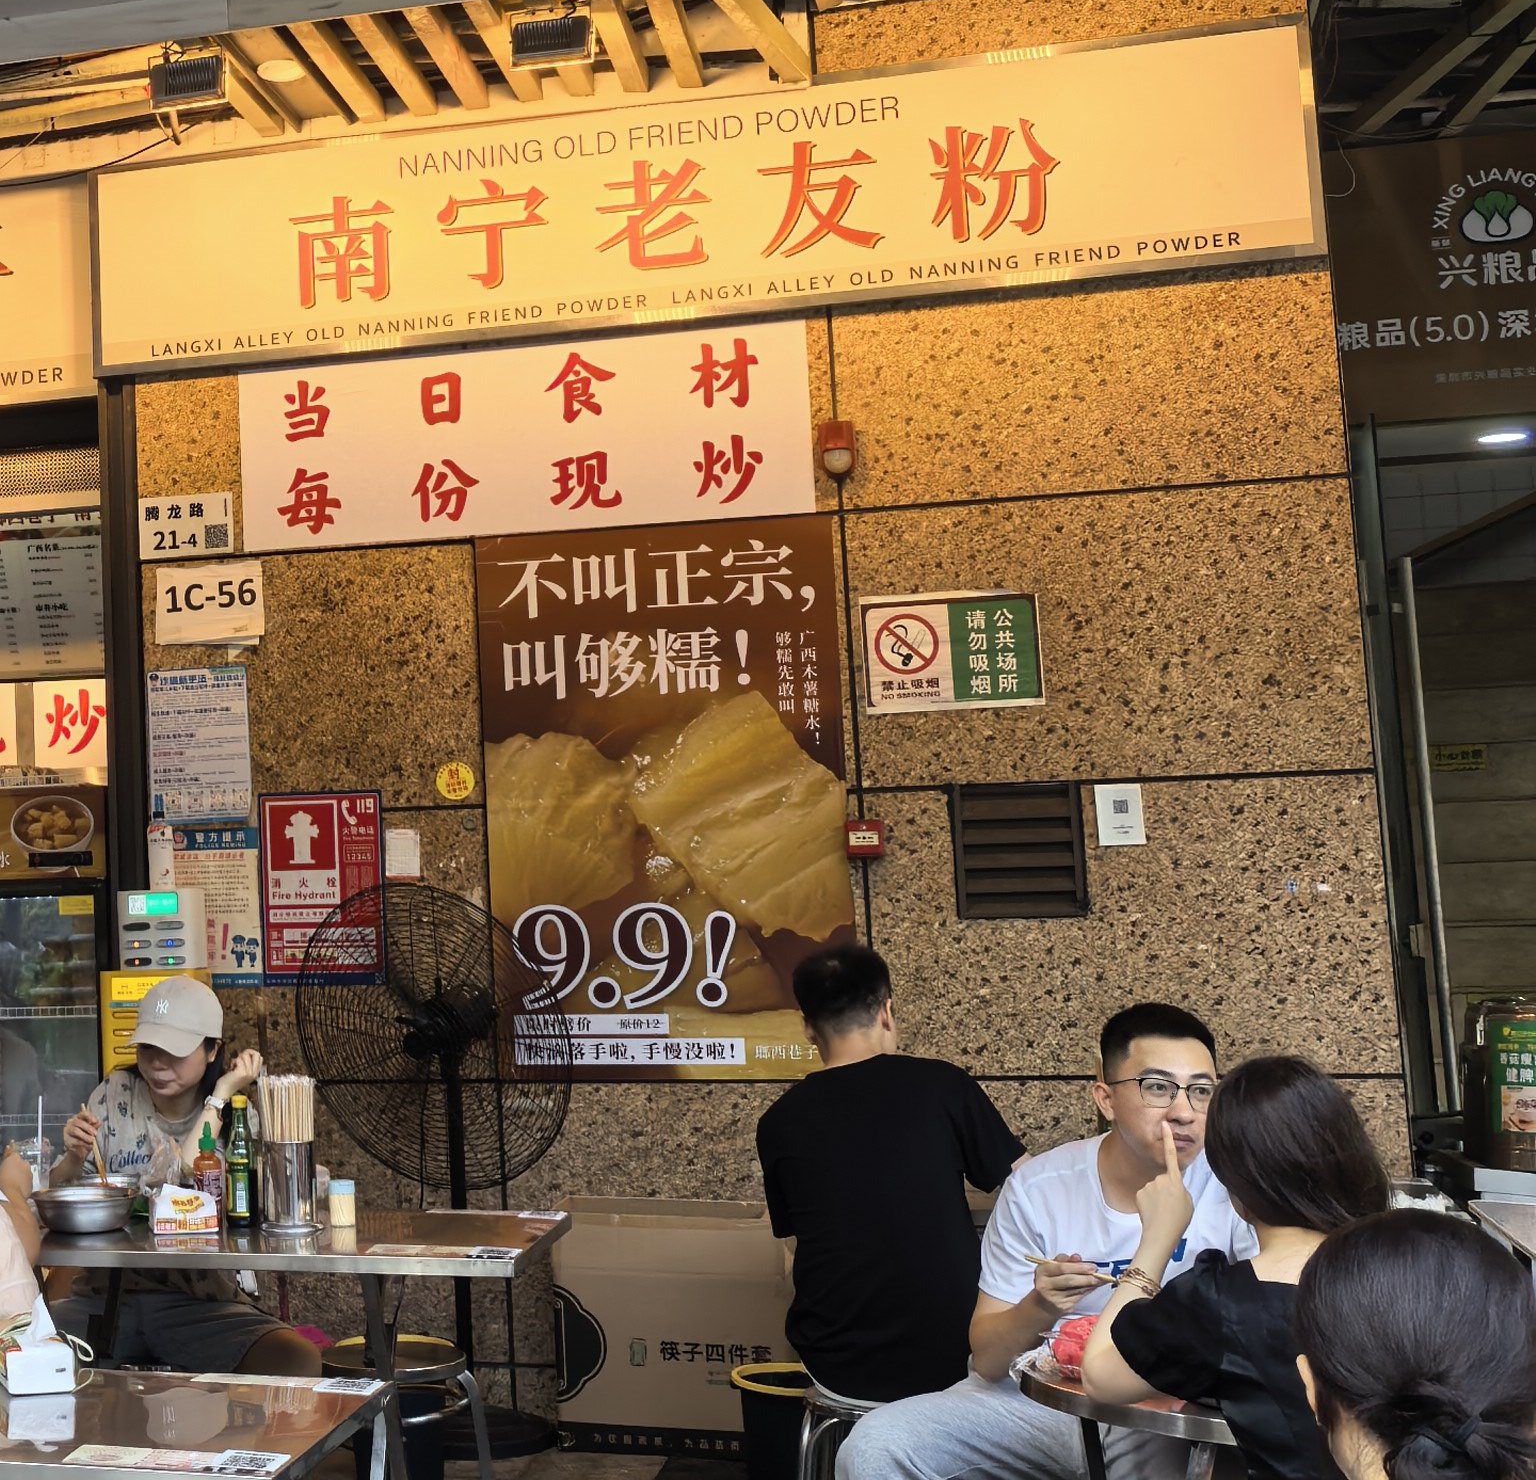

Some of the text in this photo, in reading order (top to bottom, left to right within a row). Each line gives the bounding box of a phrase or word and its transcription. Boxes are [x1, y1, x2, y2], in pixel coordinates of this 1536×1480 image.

[399, 95, 901, 179] NANNING OLD FRIEND POWDER
[1466, 168, 1536, 188] LIANG
[288, 119, 1061, 309] 南宁老友粉
[1432, 182, 1466, 230] XING
[151, 231, 1242, 357] LANGXI ALLEY OLD NANNING FRIEND POWDER LANGXI ALLEY OLD NANNING FRIEND POWDER
[1337, 308, 1536, 352] 粮品(5.0)深
[284, 338, 759, 442] 当日食材
[277, 434, 764, 535] 每份现炒
[144, 502, 205, 521] 腾龙路
[152, 530, 198, 551] 21-4
[165, 578, 257, 615] 1C-56
[497, 539, 817, 619] 不叫正宗，
[502, 626, 752, 700] 叫够糯！
[775, 630, 796, 714] 够糯先敢叫
[965, 610, 991, 695] 请勿吸烟
[993, 608, 1018, 693] 公共场所
[799, 629, 822, 745] 广西木薯糖水！
[880, 677, 940, 692] 禁止吸烟
[881, 690, 941, 701] NO SMOKING
[356, 798, 374, 813] 119
[271, 876, 337, 889] 消火栓
[272, 890, 336, 902] Fire Hydrant
[659, 1340, 772, 1364] 筷子四件套
